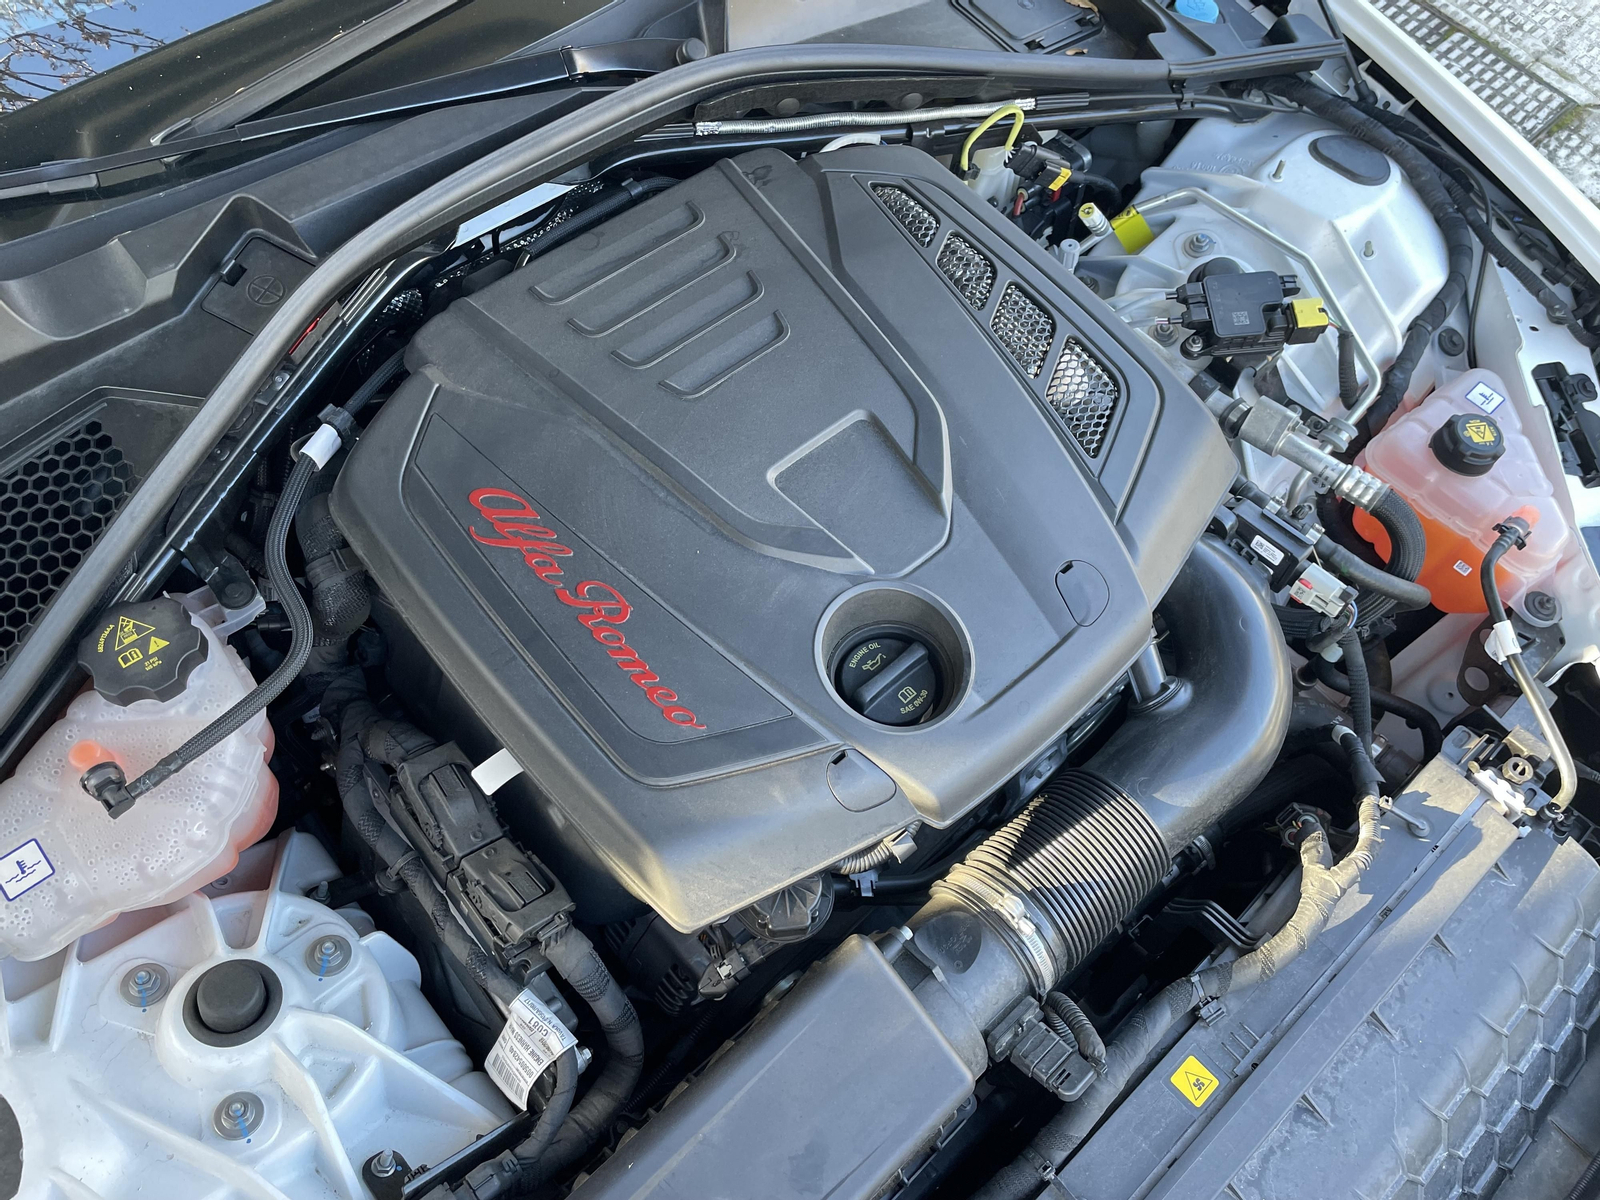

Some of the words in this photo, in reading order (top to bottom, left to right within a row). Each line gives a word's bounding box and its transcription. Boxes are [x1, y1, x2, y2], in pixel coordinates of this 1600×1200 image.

[468, 487, 573, 586] Alfa
[555, 580, 707, 729] Romeo
[849, 647, 869, 668] ENGINE
[868, 642, 881, 650] OIL
[900, 703, 915, 714] SAE
[913, 689, 928, 707] 0W-30
[528, 1017, 549, 1037] C081
[513, 1032, 532, 1052] HARNESS
[527, 1049, 544, 1066] ENGINE
